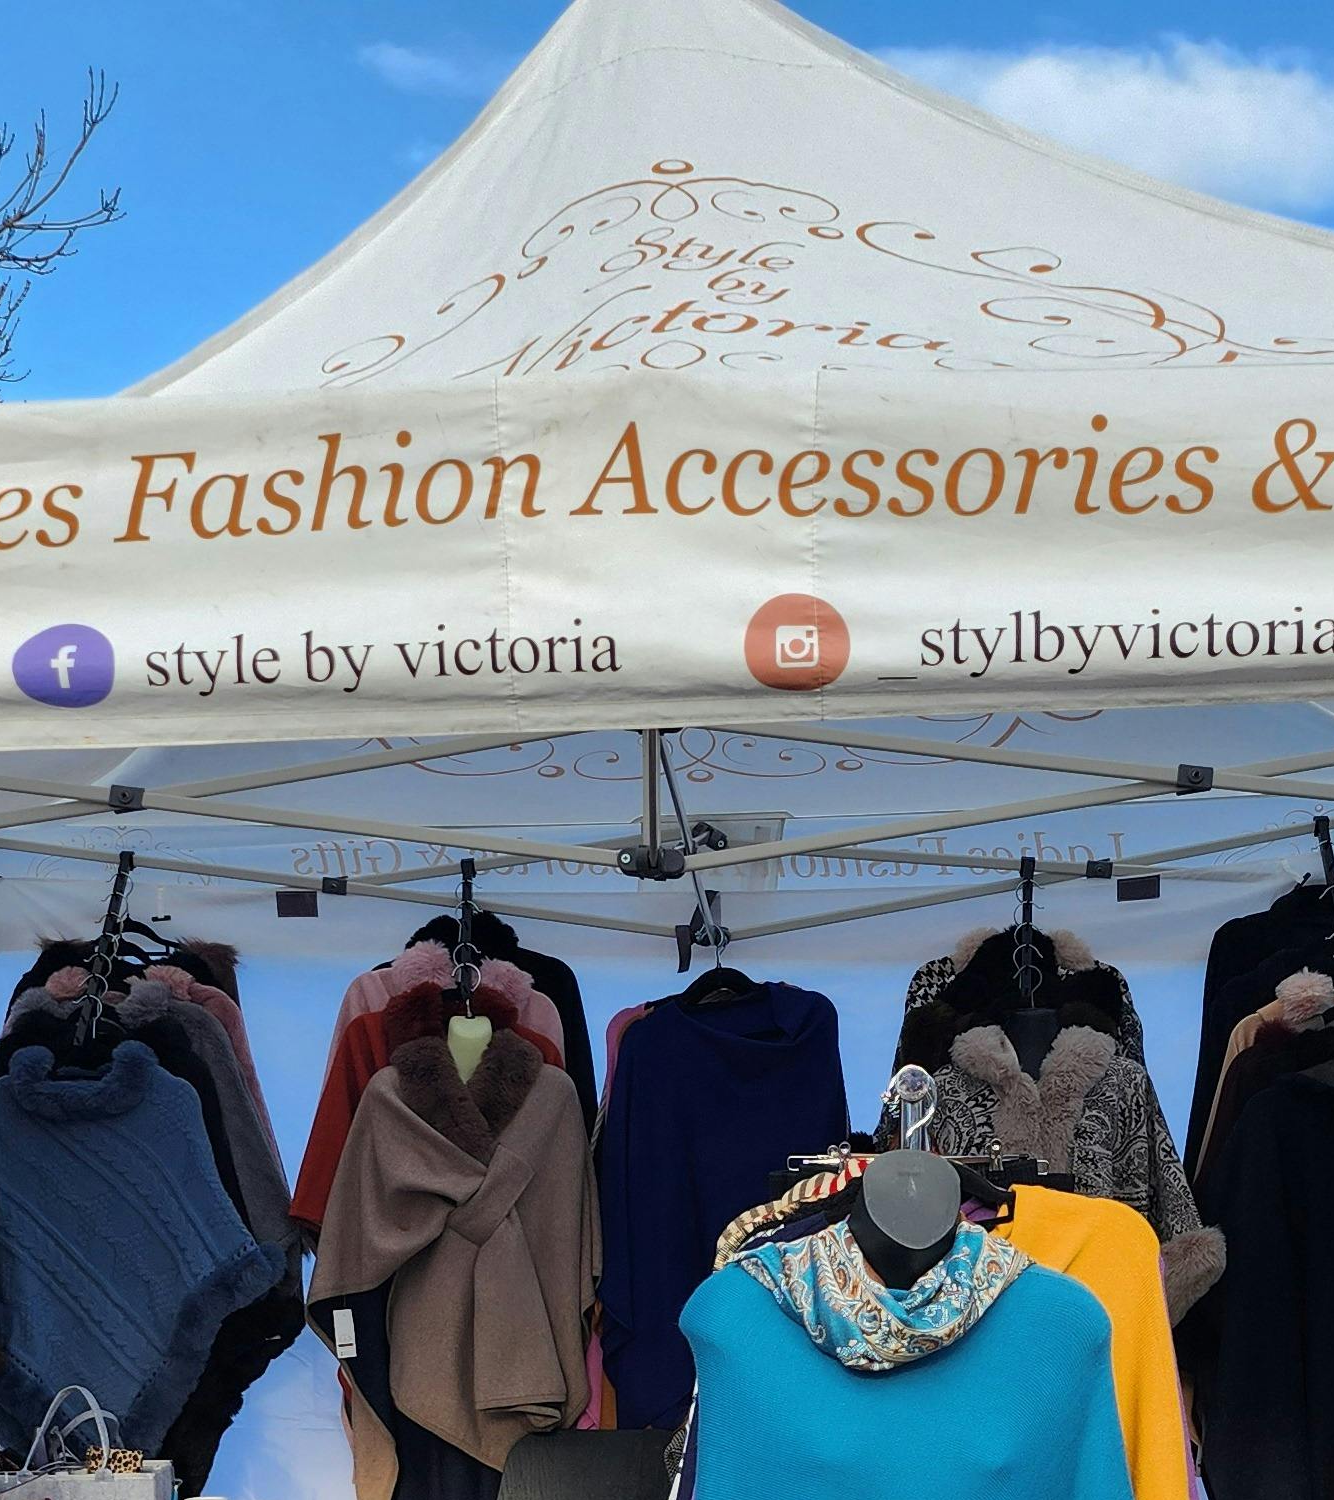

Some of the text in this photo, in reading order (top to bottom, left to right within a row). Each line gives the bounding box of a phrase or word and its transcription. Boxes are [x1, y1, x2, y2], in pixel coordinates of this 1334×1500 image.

[587, 227, 805, 275] Style
[707, 267, 791, 305] by
[114, 430, 546, 543] Fashion
[570, 413, 1218, 518] Accessories
[146, 633, 281, 697] style
[304, 631, 375, 693] by
[395, 618, 622, 679] victoria
